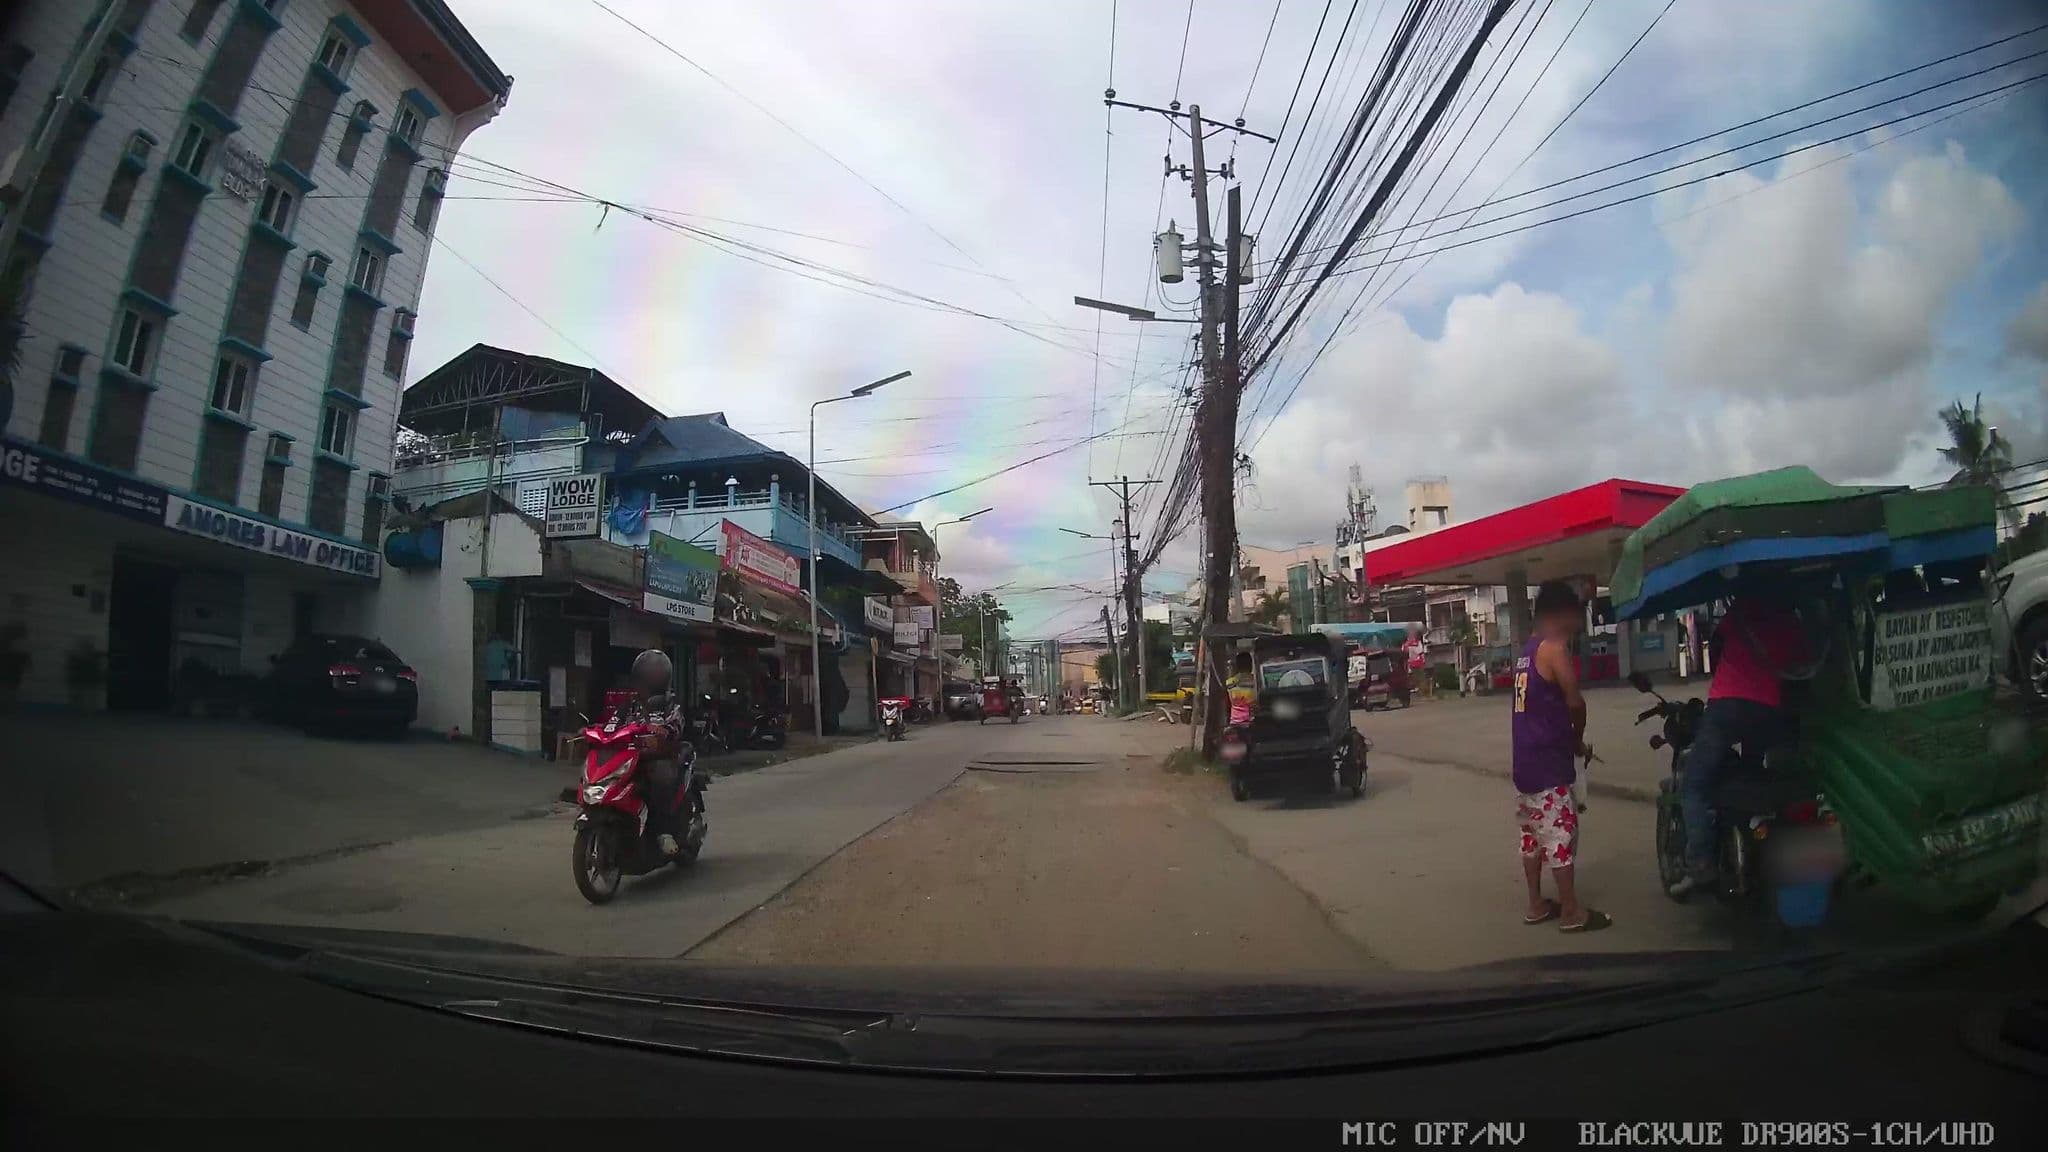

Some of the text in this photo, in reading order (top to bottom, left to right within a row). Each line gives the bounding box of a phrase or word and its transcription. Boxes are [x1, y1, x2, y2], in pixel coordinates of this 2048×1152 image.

[552, 478, 597, 496] WOW
[552, 493, 595, 507] LODGE
[177, 504, 376, 576] AMORES LAW OFFICE
[678, 604, 696, 617] STORE
[1919, 611, 1932, 632] AY
[1916, 639, 1930, 657] AY
